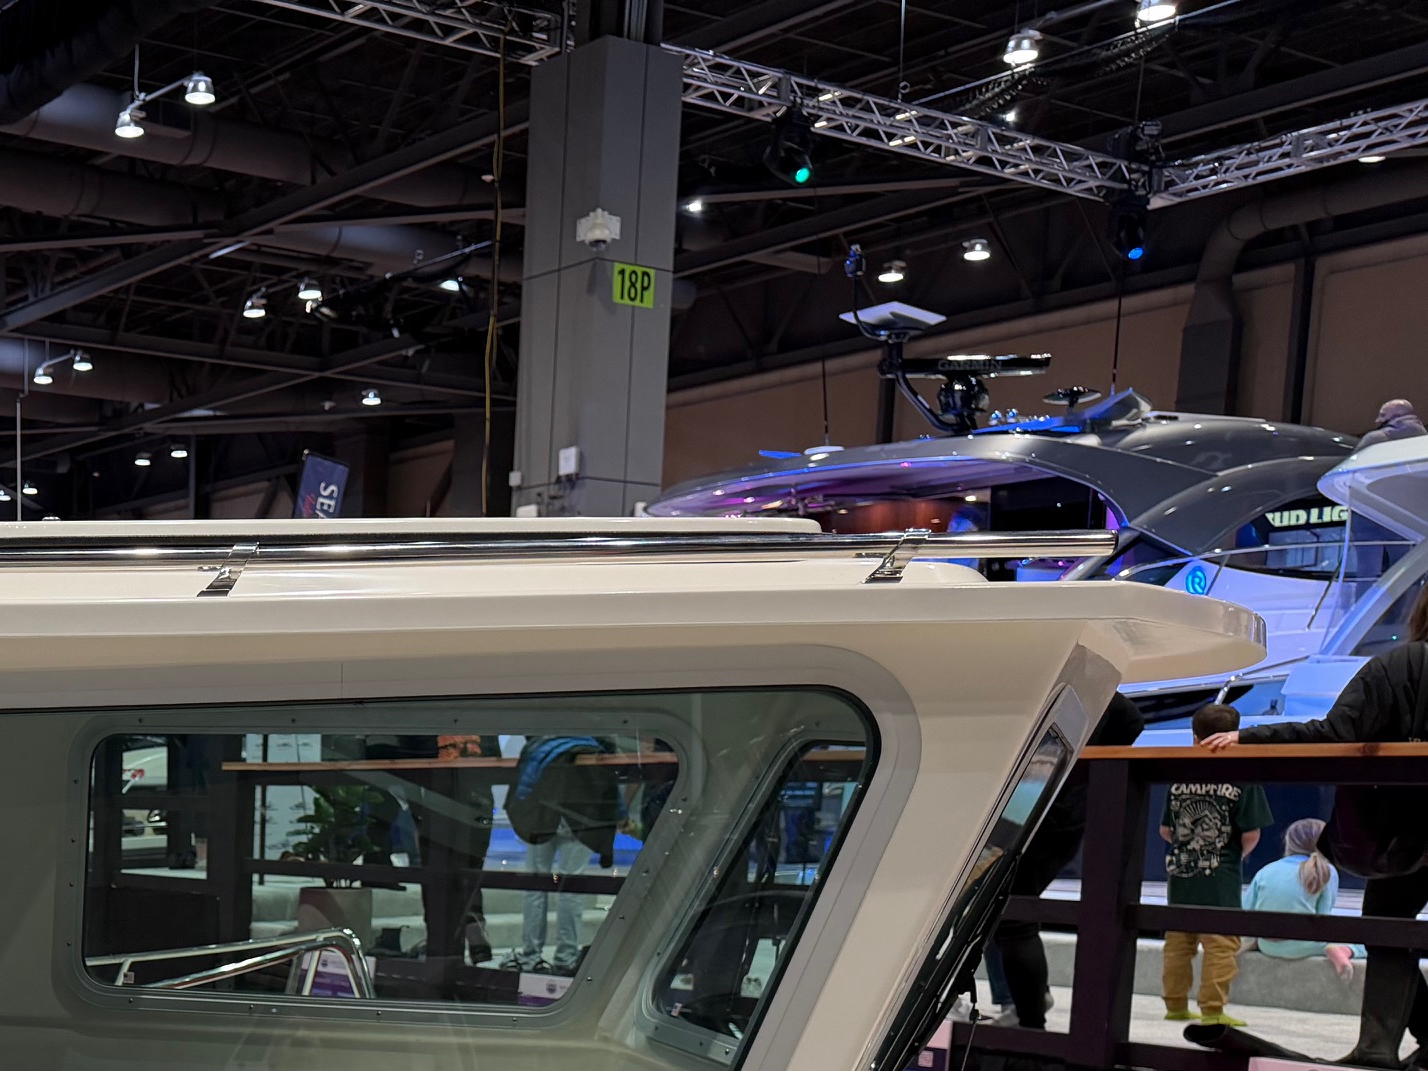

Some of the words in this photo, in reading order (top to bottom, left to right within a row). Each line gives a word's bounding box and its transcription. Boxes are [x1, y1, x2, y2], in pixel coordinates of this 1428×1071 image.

[618, 268, 651, 304] 18P
[937, 359, 1003, 371] GARMIN
[1265, 509, 1308, 527] UD
[1171, 783, 1242, 801] CAMPFIRE
